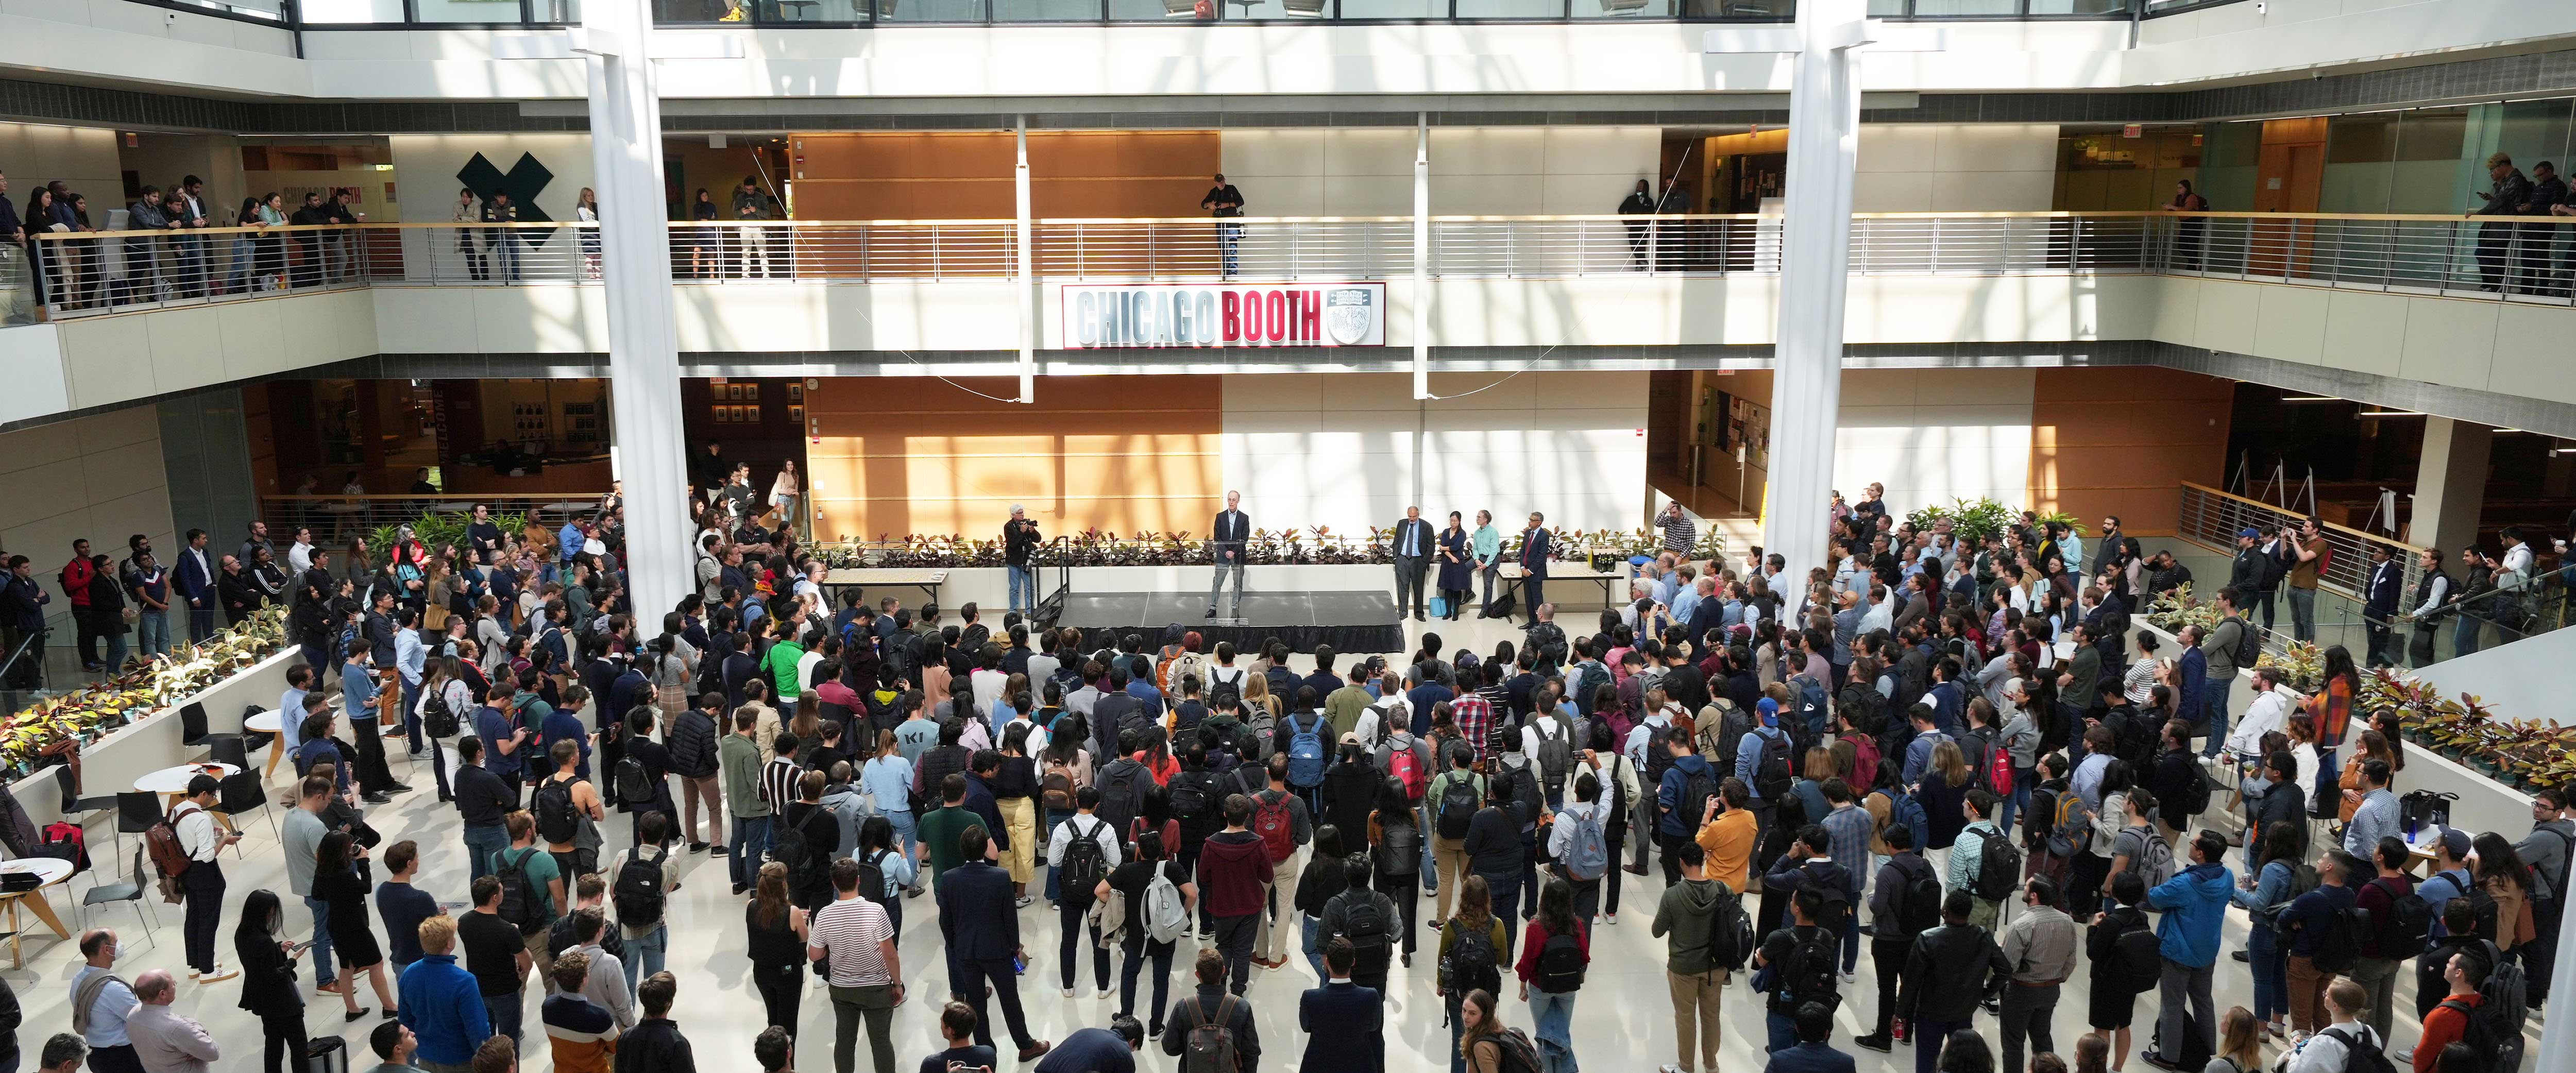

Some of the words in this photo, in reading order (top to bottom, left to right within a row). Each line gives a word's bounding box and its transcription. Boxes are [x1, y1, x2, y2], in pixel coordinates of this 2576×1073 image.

[2125, 127, 2141, 136] EXIT
[329, 187, 362, 204] BTH
[1077, 290, 1215, 343] CHICAGO
[1222, 290, 1321, 342] BOOTH
[904, 731, 923, 744] KI
